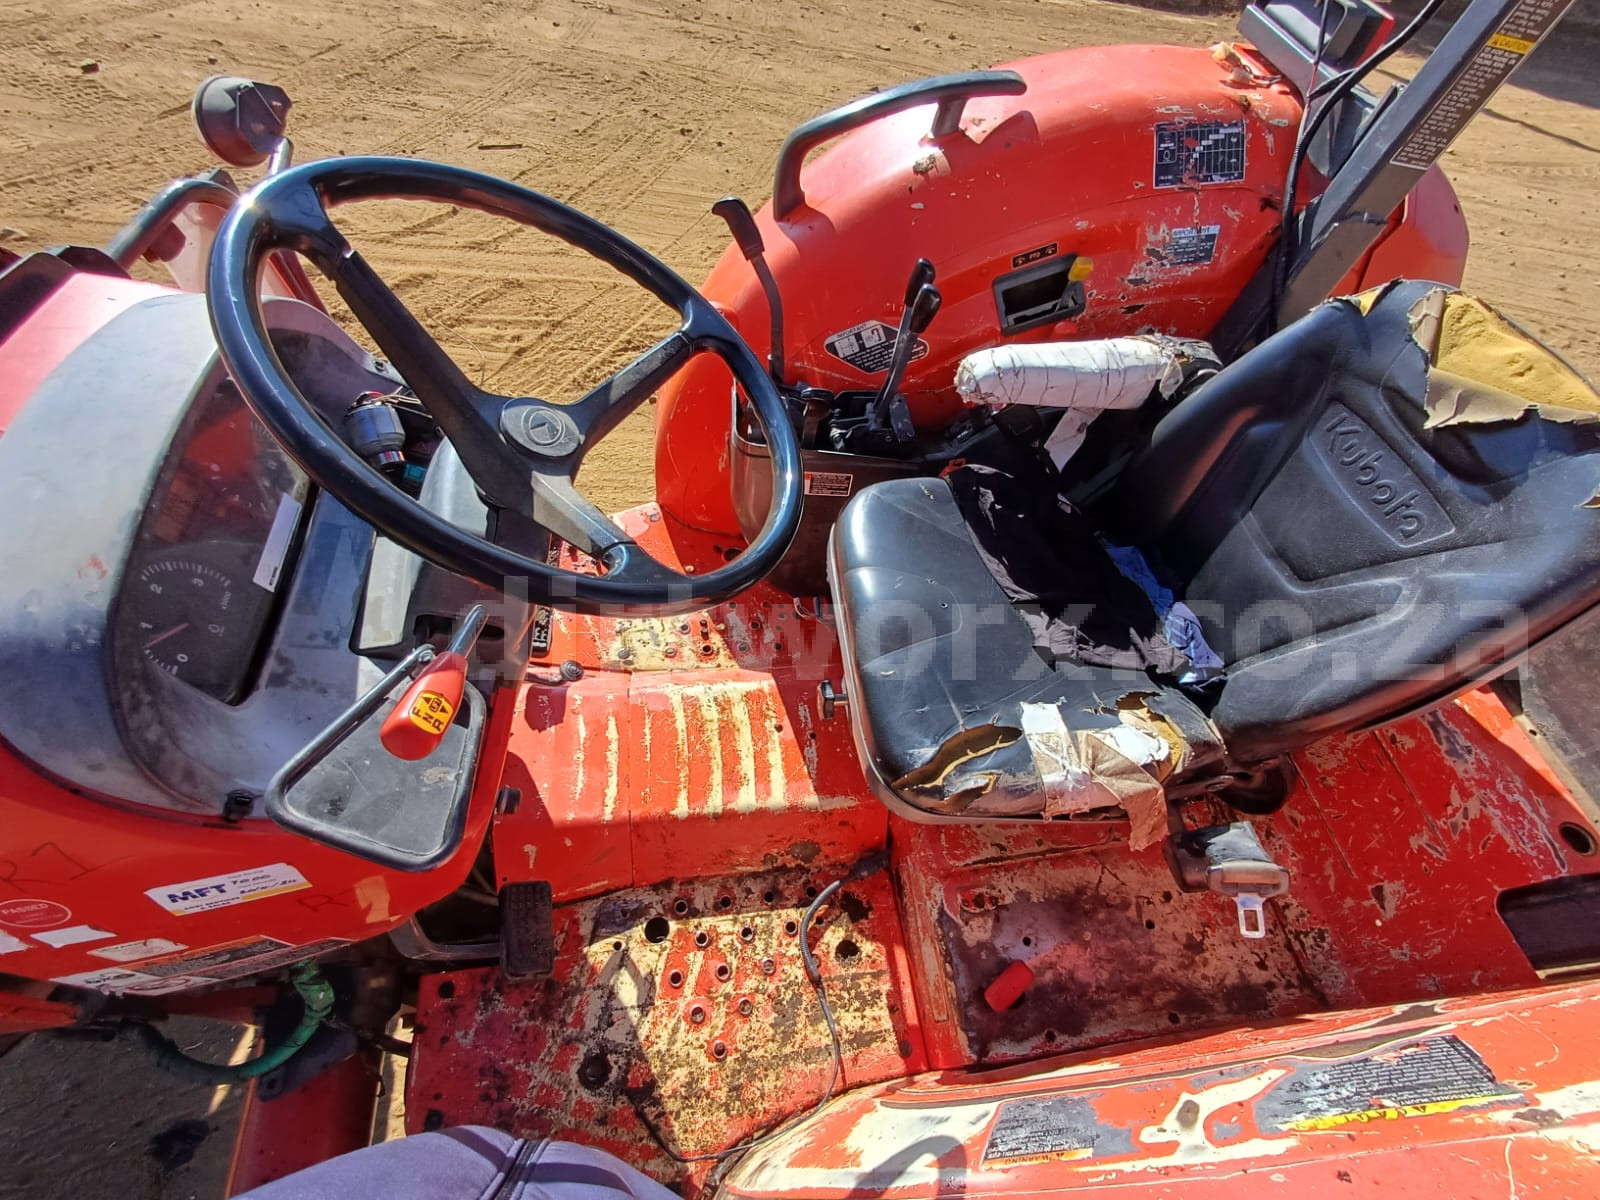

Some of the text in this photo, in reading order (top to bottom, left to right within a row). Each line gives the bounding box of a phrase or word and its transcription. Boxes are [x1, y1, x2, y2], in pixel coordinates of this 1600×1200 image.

[836, 323, 868, 338] IMPORTANT
[1324, 411, 1437, 539] Kubota
[150, 583, 163, 595] 2
[176, 653, 189, 663] 0
[411, 706, 445, 732] F N R
[168, 884, 227, 903] MFT
[1004, 1154, 1049, 1165] WARNING
